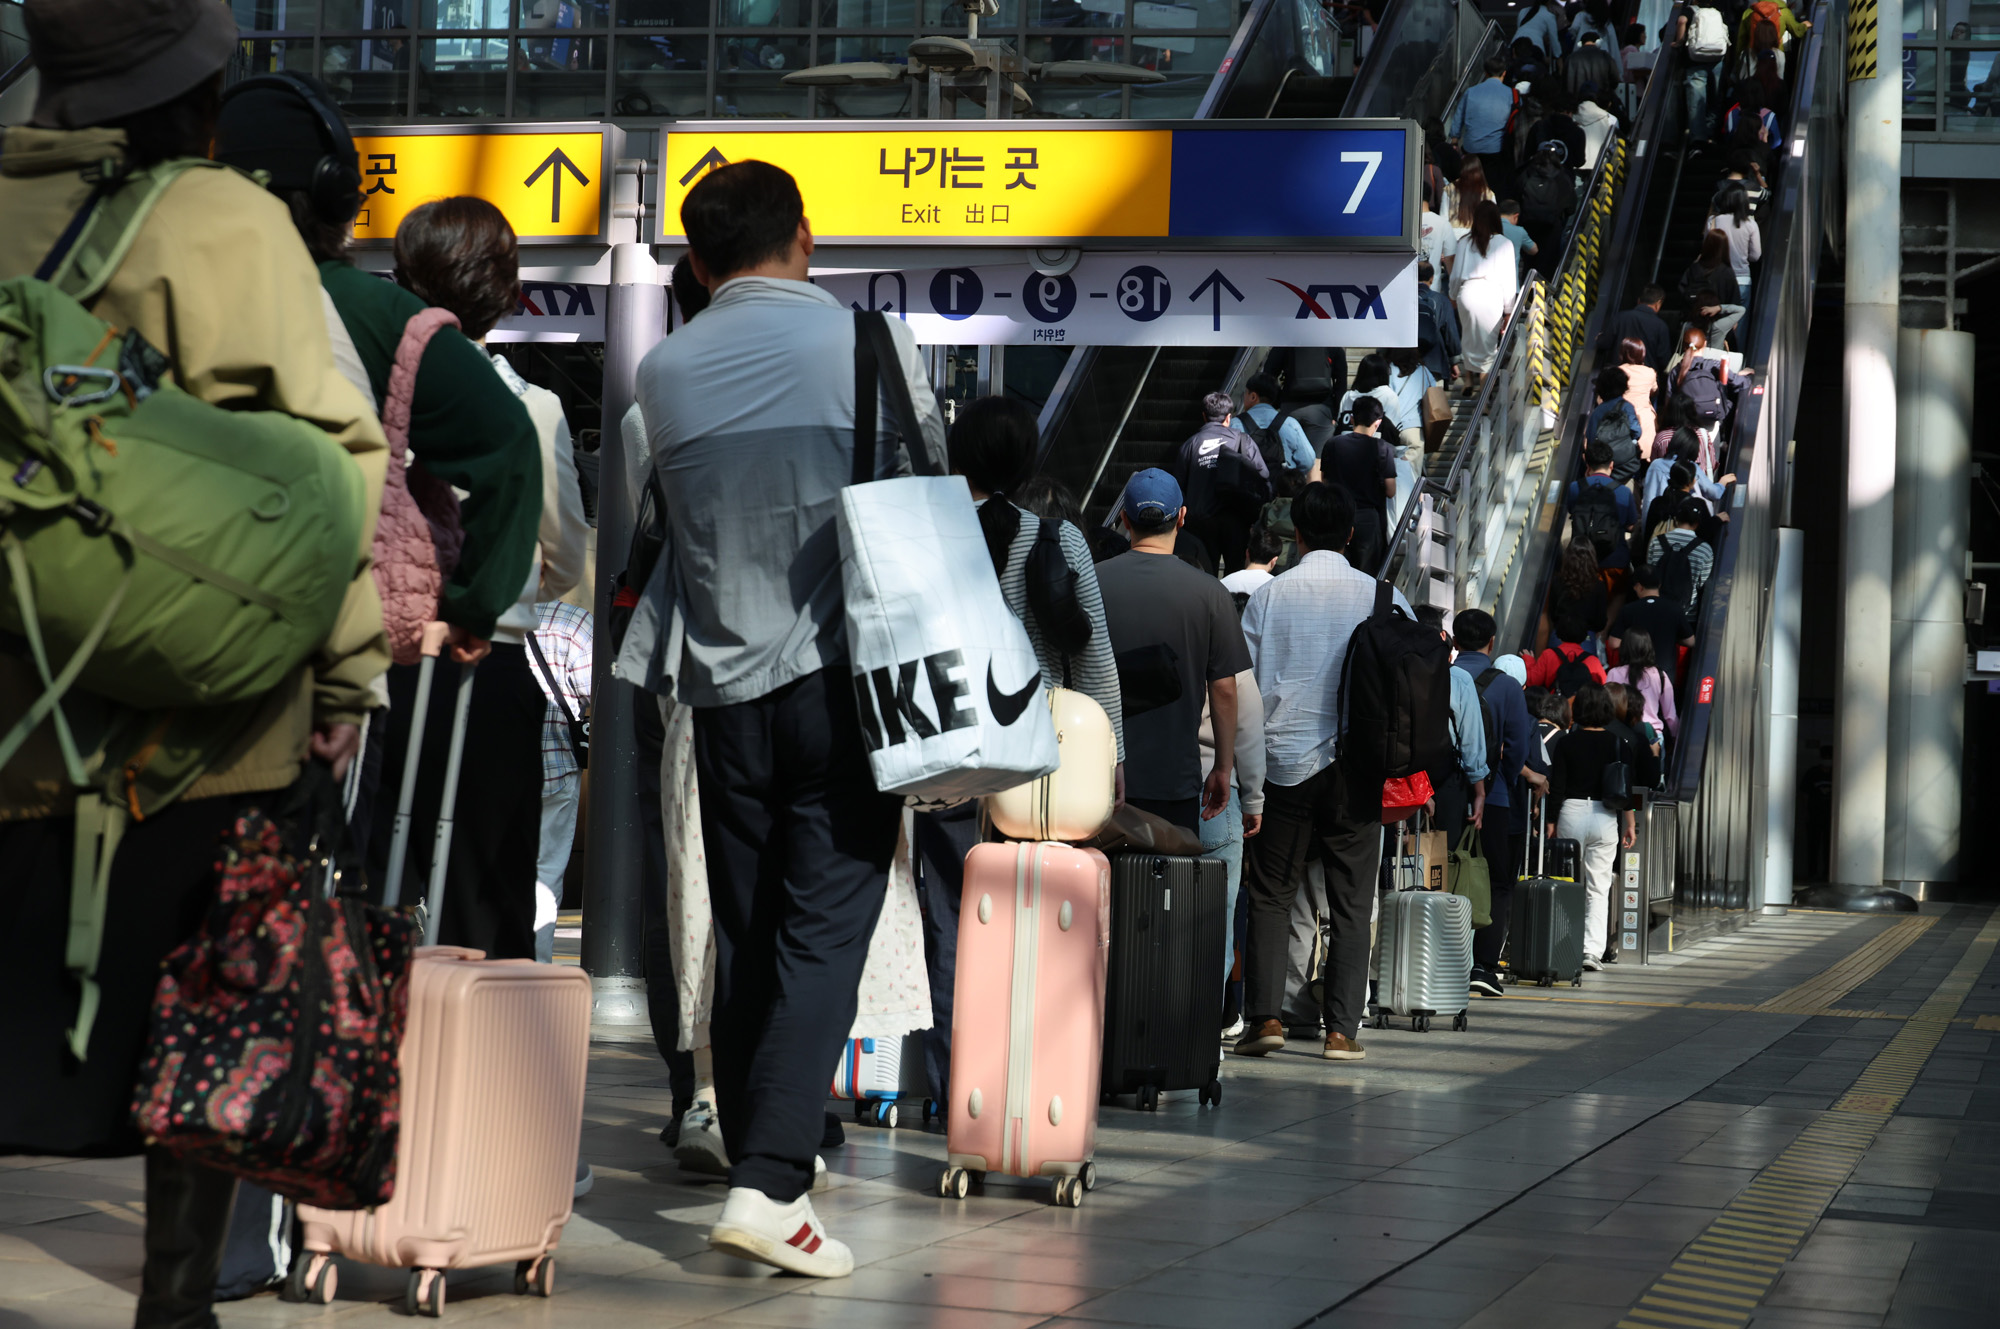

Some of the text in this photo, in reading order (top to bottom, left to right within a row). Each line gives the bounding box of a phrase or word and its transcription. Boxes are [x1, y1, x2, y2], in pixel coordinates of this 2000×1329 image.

[365, 154, 397, 194] 곳
[880, 148, 1038, 190] 나가는 곳
[1340, 152, 1383, 213] 7
[902, 204, 941, 223] Exit
[966, 204, 1010, 224] 出口
[853, 648, 979, 753] IKE
